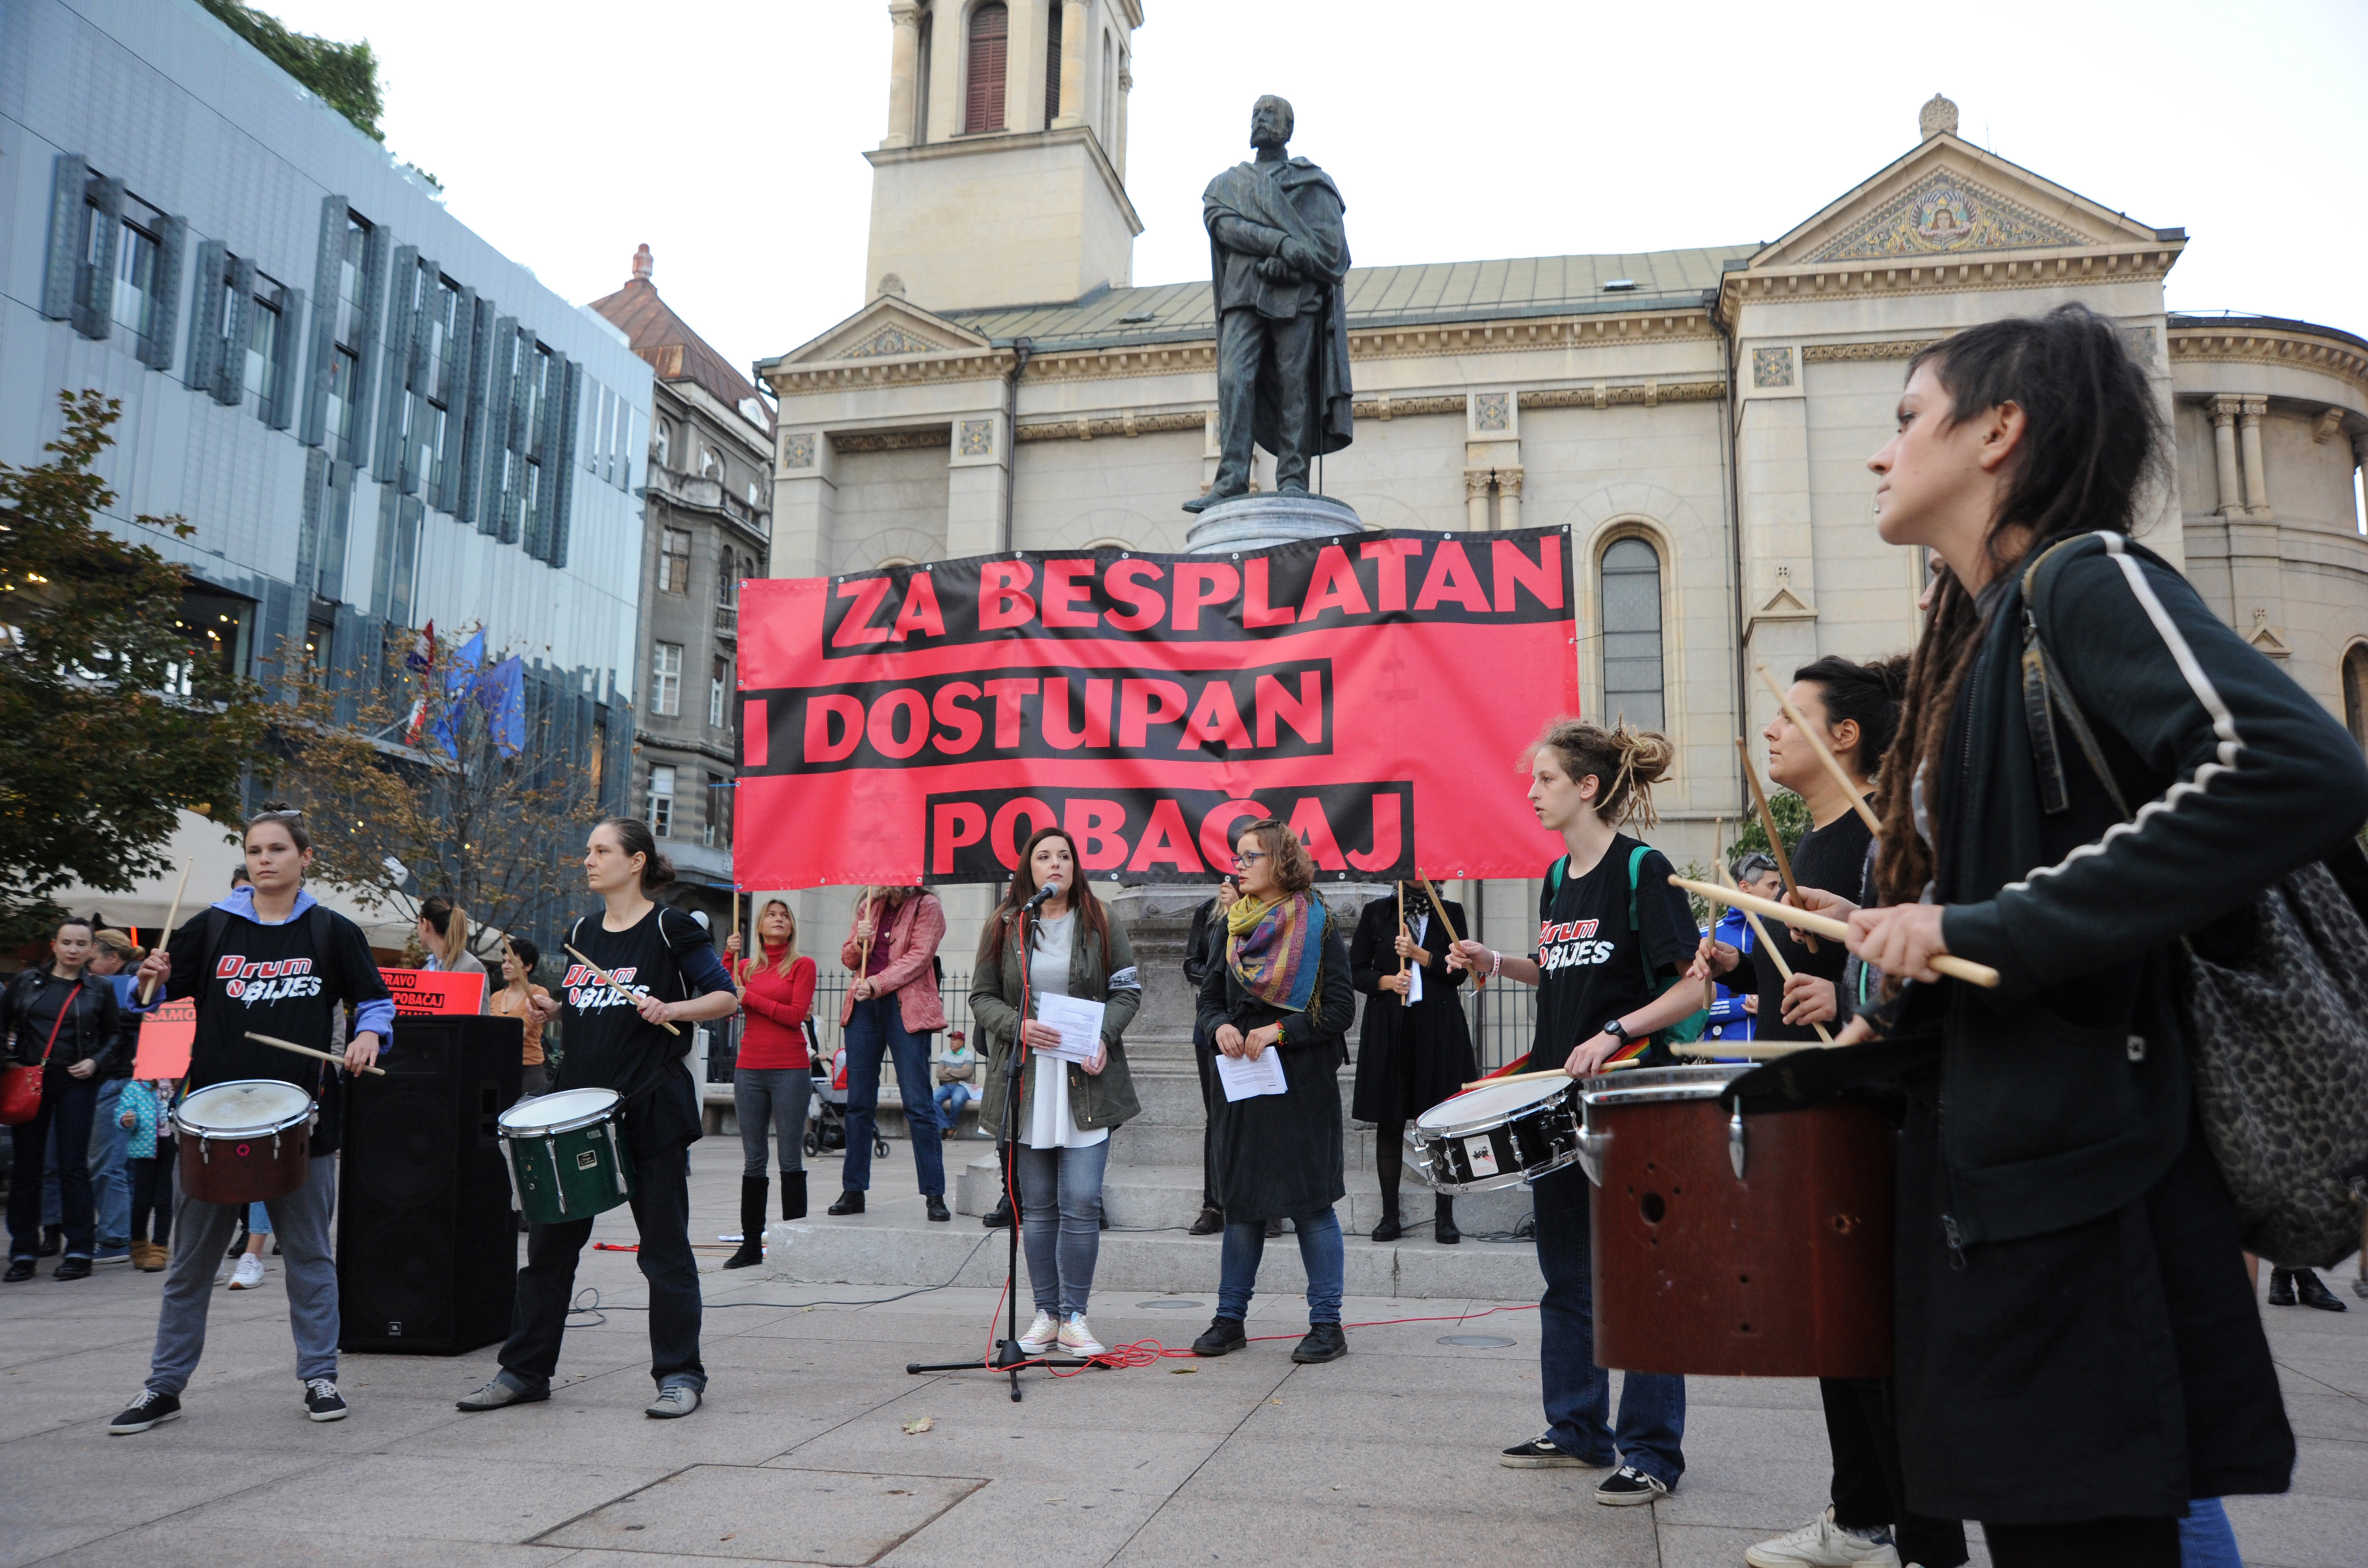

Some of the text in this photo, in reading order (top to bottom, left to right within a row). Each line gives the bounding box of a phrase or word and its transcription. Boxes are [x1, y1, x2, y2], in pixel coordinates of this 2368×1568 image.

[832, 535, 1564, 648] ZA BESPLATAN
[743, 670, 1323, 766] I DOSTUPAN
[932, 789, 1401, 874] POBAČAJ
[216, 955, 312, 979] Drum
[241, 976, 323, 1002] BIJES
[393, 992, 444, 1007] POBAČAJ
[145, 1009, 196, 1022] SAMO
